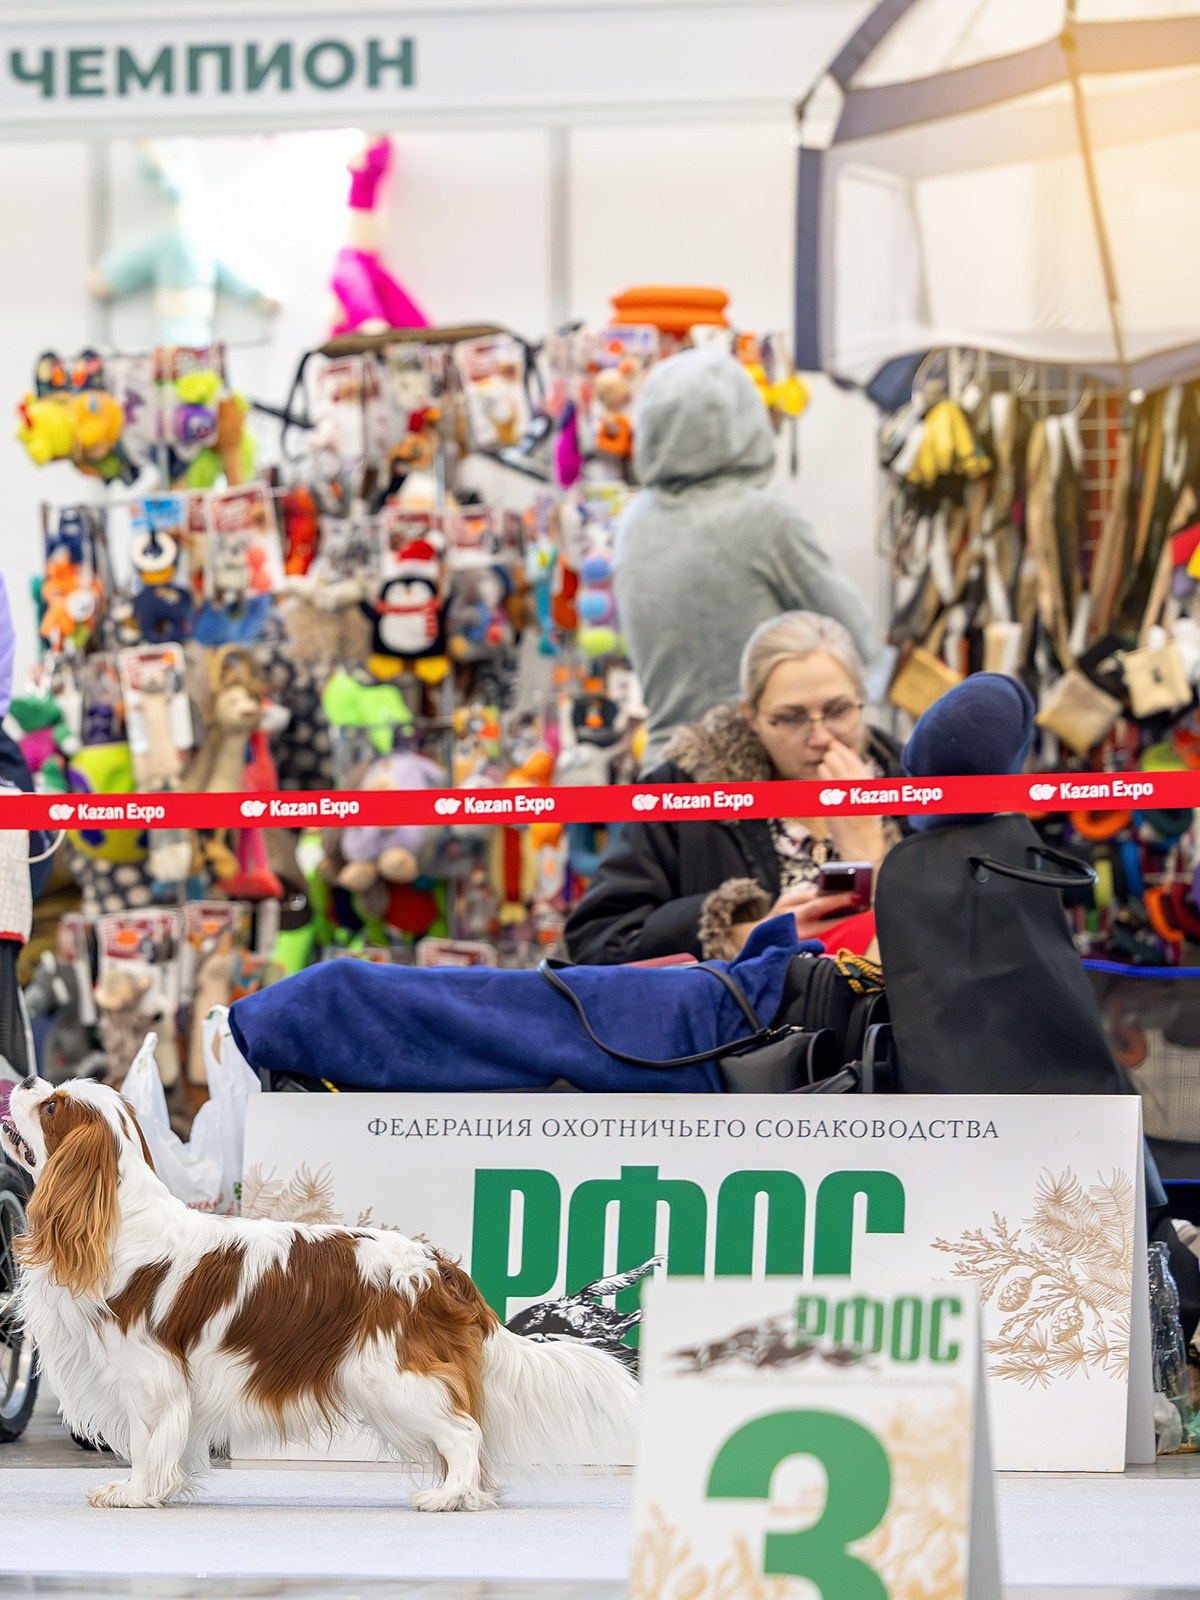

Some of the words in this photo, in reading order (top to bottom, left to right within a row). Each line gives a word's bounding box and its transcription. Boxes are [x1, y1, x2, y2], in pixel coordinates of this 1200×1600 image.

[11, 36, 417, 100] ЧЕМПИОН
[662, 792, 711, 810] Kazan
[713, 790, 754, 812] Expo
[849, 787, 900, 805] Kazan
[901, 785, 943, 806] Expo
[1059, 782, 1110, 800] Kazan
[1112, 779, 1154, 801] Expo
[77, 803, 125, 820] Kazan
[126, 802, 165, 823] Expo
[269, 799, 318, 817] Kazan
[319, 797, 360, 819] Expo
[464, 796, 513, 814] Kazan
[514, 794, 555, 816] Expo
[367, 1117, 533, 1140] ФЕДЕРАЦИЯ
[541, 1117, 746, 1139] ОХОТНИЧЬЕГО
[755, 1118, 1000, 1141] СОБАКОВОДСТВА
[705, 1409, 891, 1600] 3
